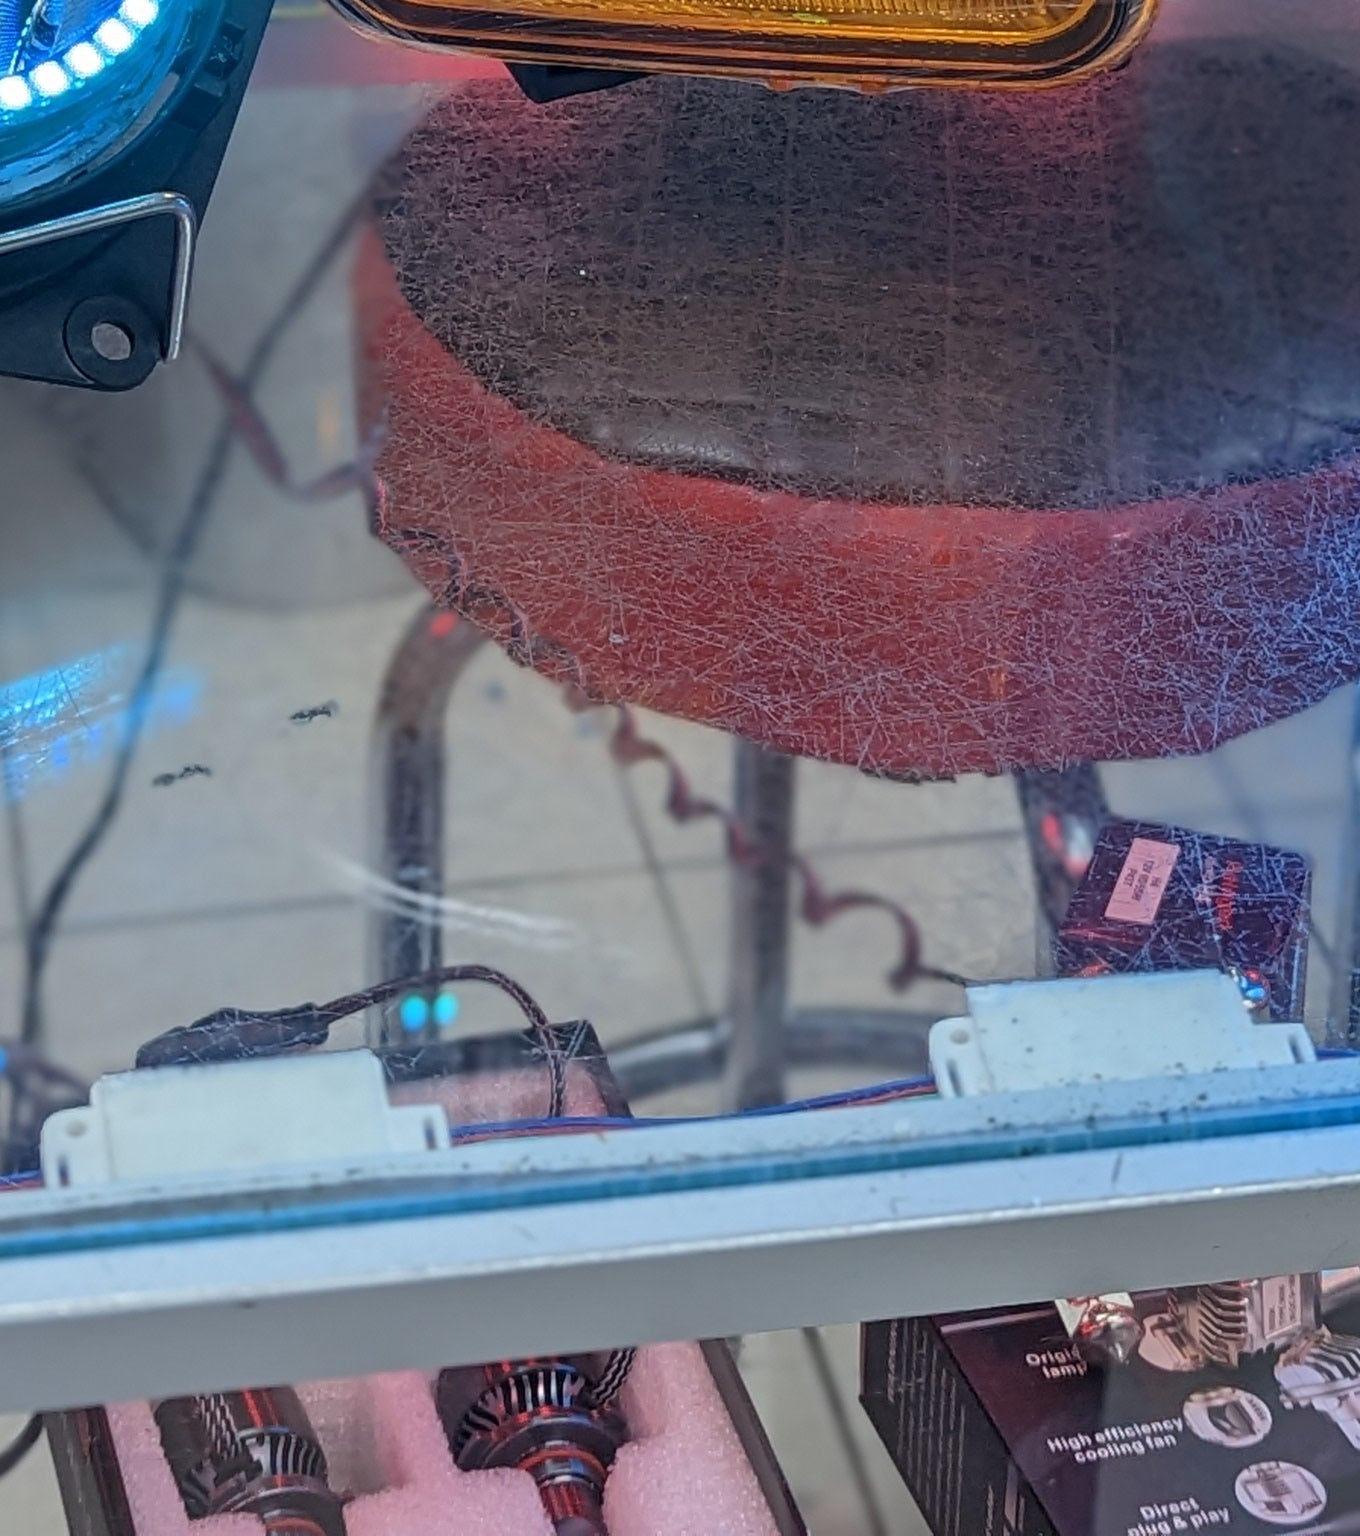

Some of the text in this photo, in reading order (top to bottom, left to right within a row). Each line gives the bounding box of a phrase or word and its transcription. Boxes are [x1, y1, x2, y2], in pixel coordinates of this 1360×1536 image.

[1041, 1359, 1088, 1380] lamp
[1046, 1416, 1185, 1454] High efficiency
[1074, 1432, 1178, 1464] cooling fan
[1126, 1507, 1230, 1536] plug & play
[1138, 1496, 1200, 1521] Direct
